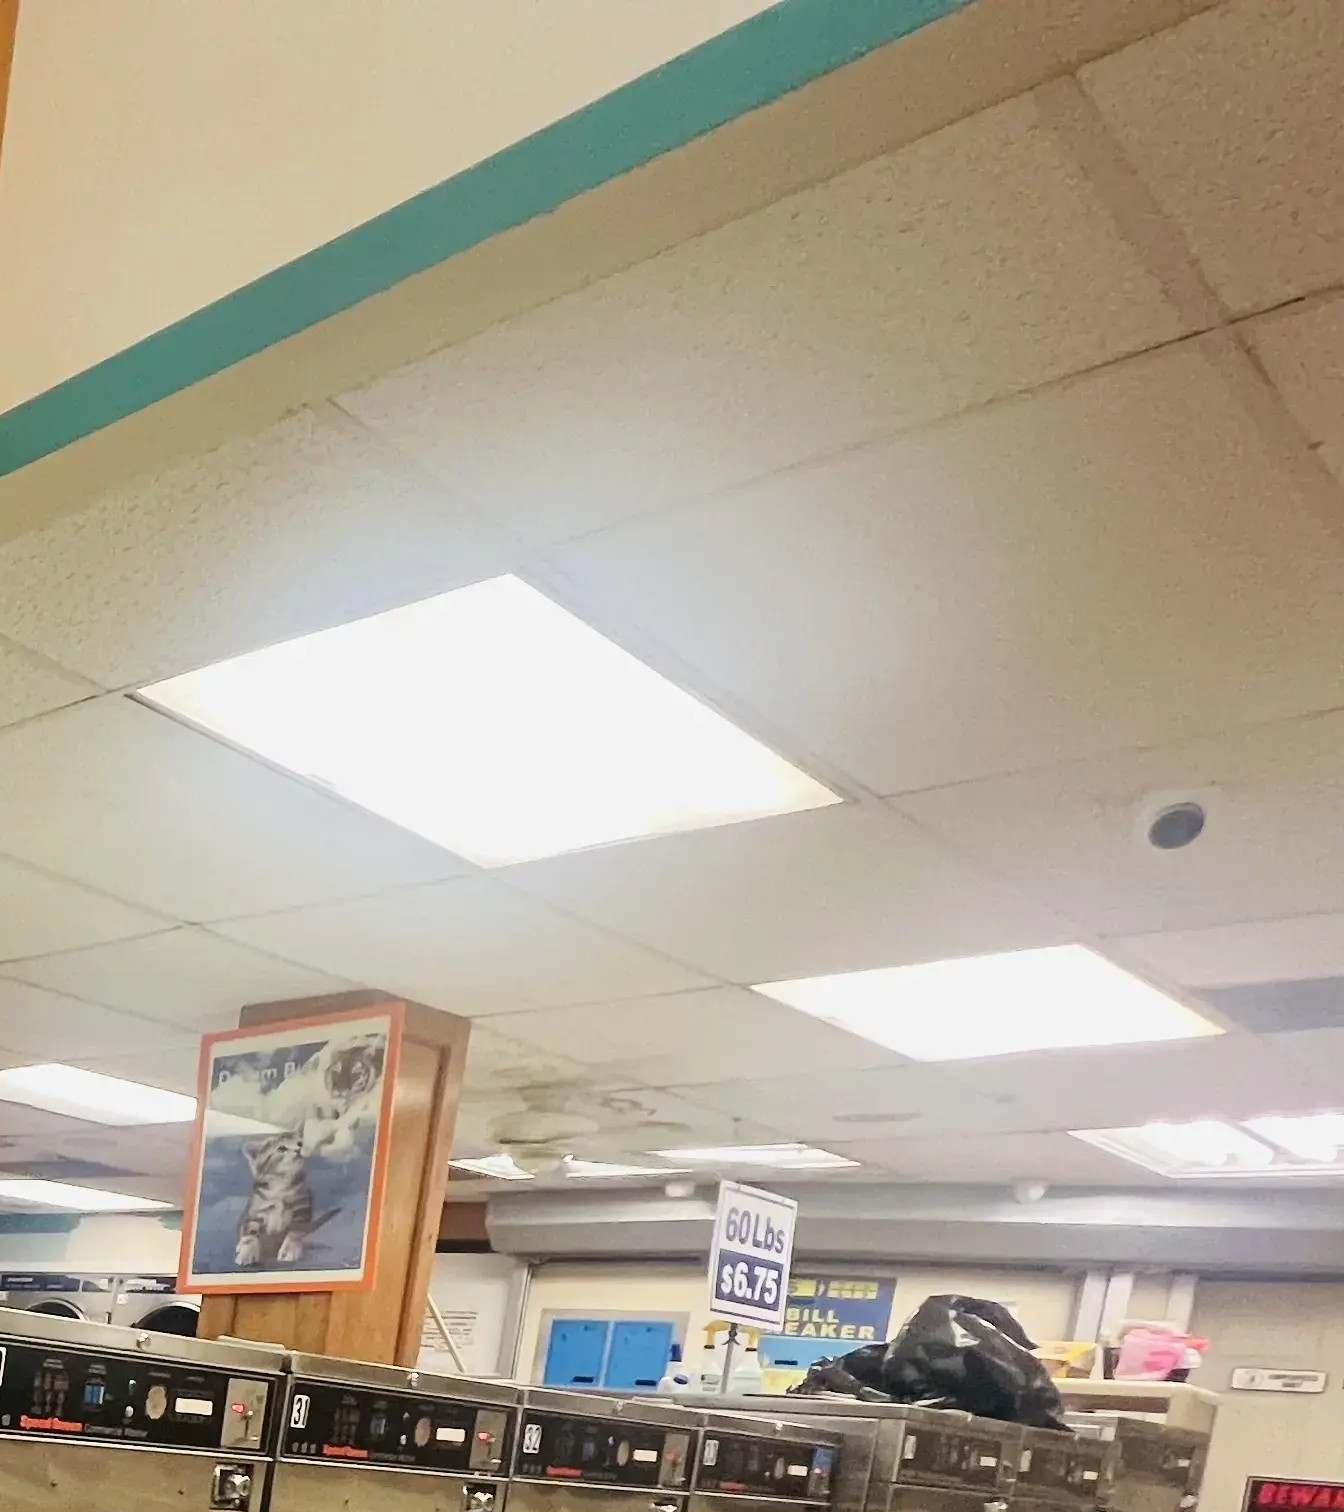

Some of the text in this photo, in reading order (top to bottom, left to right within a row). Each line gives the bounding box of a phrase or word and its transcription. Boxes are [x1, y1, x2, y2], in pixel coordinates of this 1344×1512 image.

[725, 1206, 786, 1254] 60Lbs
[720, 1261, 780, 1305] $6.75
[786, 1307, 840, 1323] BILL
[785, 1322, 875, 1340] EAKER
[1257, 1484, 1344, 1507] BEWAR
